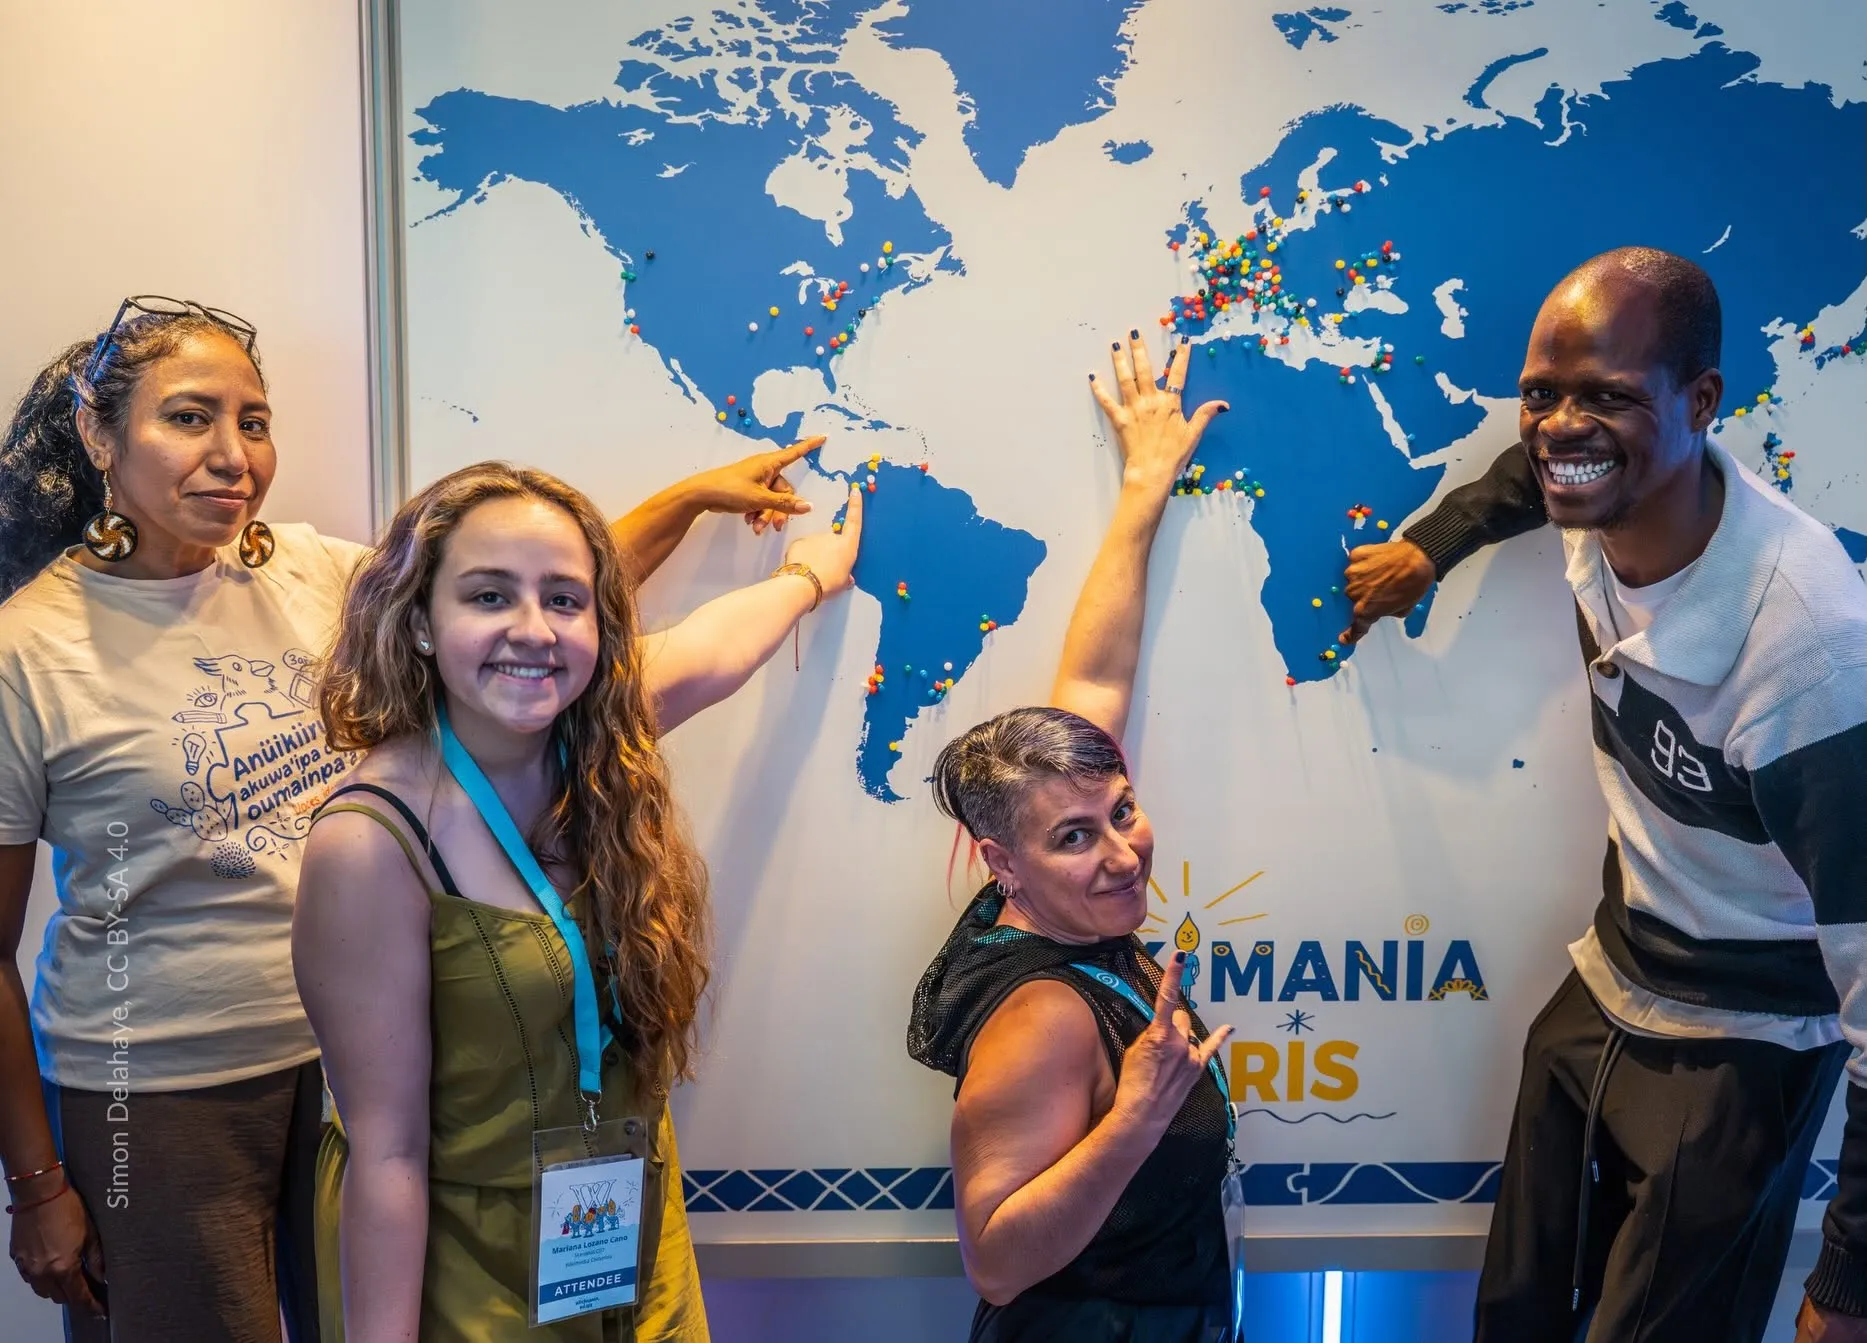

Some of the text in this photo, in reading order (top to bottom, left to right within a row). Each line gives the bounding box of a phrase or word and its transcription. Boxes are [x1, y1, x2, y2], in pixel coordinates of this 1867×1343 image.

[240, 748, 321, 801] akuwa'ipa
[1651, 720, 1713, 792] 93
[552, 1244, 582, 1255] Mariana
[583, 1238, 609, 1249] Lozano
[610, 1235, 628, 1244] Cano
[554, 1273, 622, 1297] ATTENDEE
